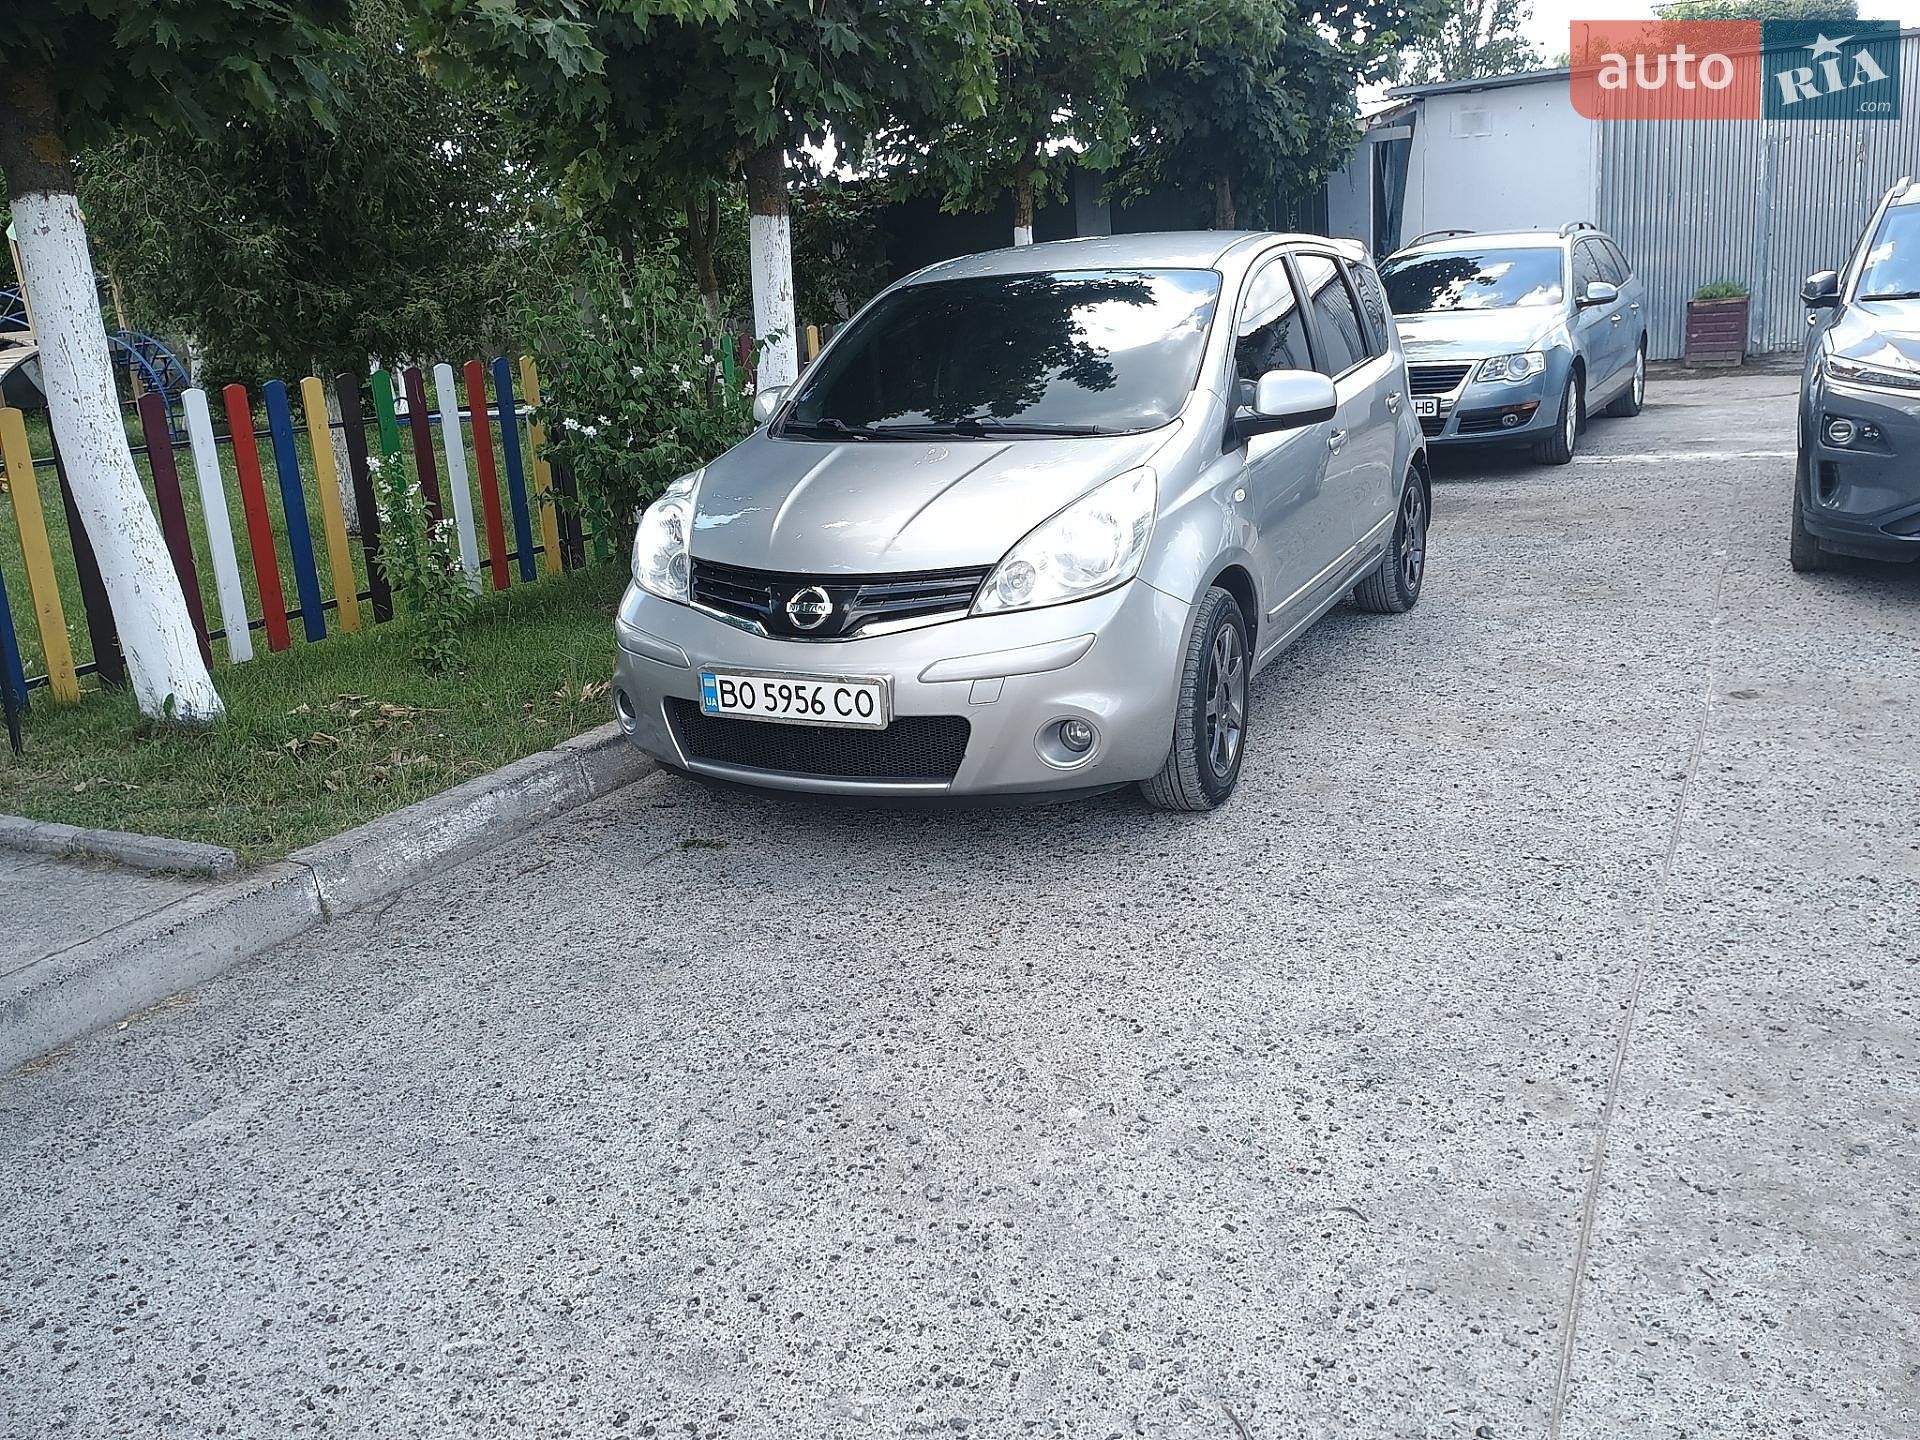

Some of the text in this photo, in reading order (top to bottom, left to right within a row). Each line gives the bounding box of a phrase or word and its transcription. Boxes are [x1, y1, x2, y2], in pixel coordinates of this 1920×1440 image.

[1415, 402, 1435, 414] HB
[706, 696, 718, 707] UA
[718, 679, 874, 718] BO 5956 CO
